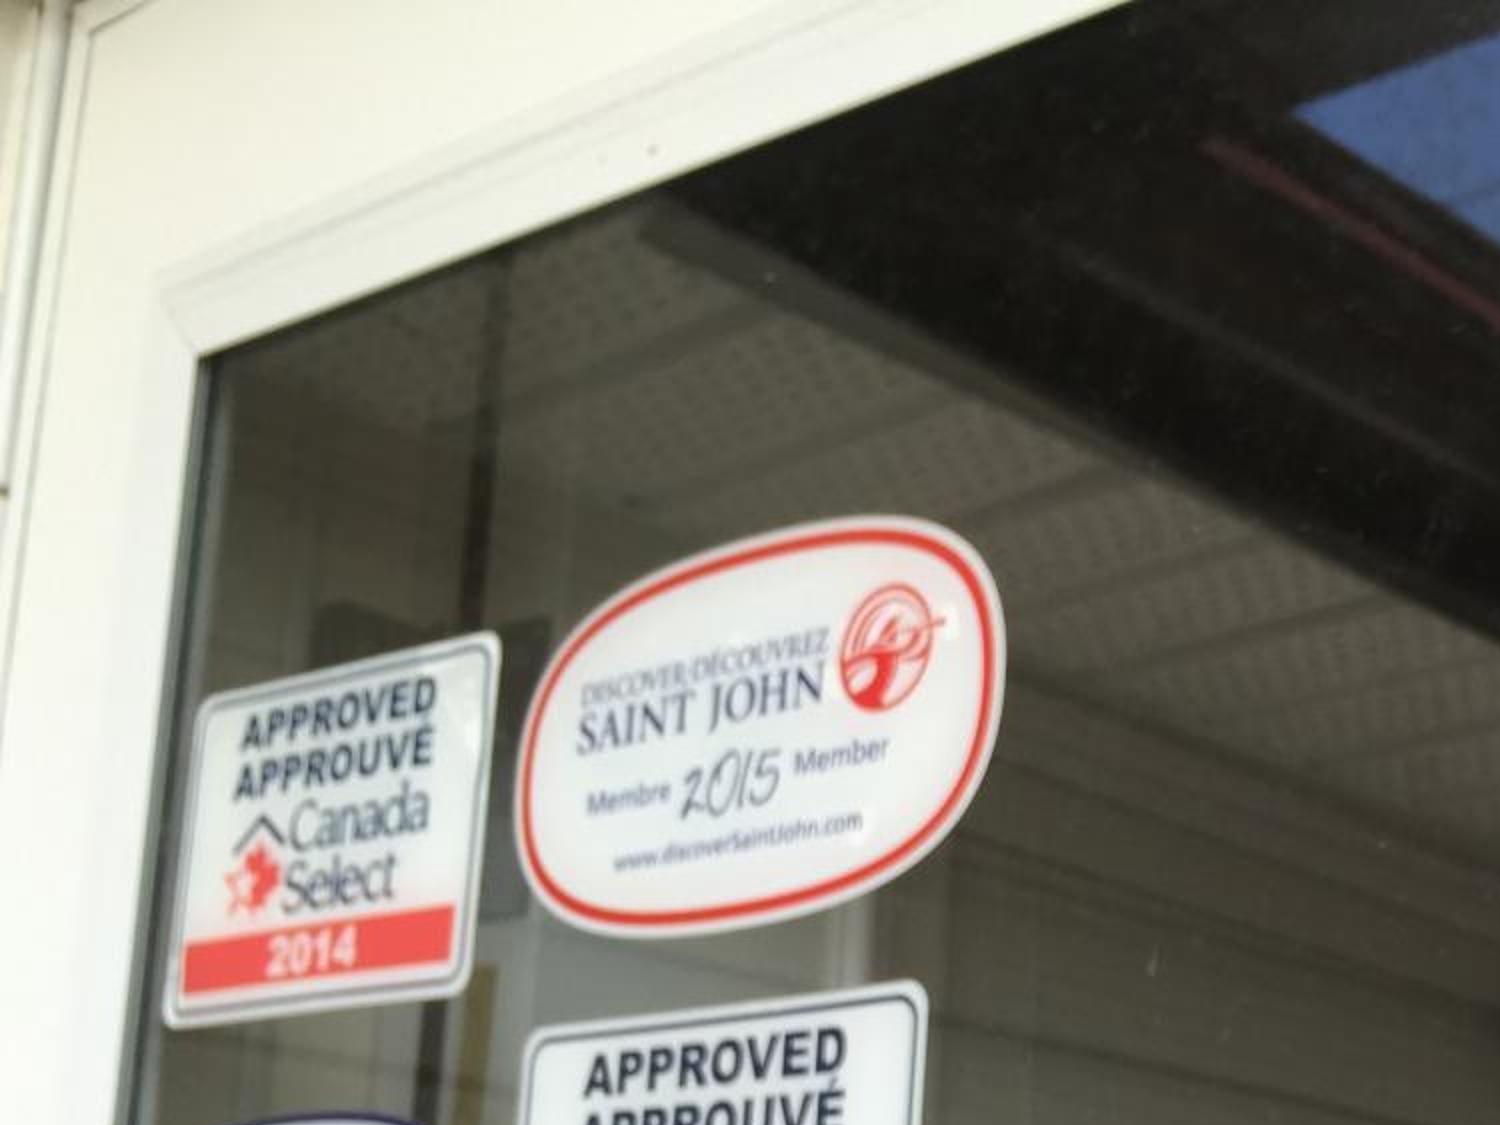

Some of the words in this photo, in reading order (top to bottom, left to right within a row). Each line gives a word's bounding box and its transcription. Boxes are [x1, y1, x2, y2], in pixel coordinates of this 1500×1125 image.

[242, 677, 437, 752] APPROVED
[577, 689, 698, 757] SAINT
[708, 660, 826, 733] JOHN
[235, 718, 432, 802] APPROUVÉ
[587, 781, 670, 816] Membre
[680, 749, 781, 820] 2015
[793, 738, 889, 775] Member
[288, 780, 430, 852] Canada
[281, 855, 397, 914] Select
[266, 926, 359, 979] 2014
[584, 1027, 846, 1098] APPROVED
